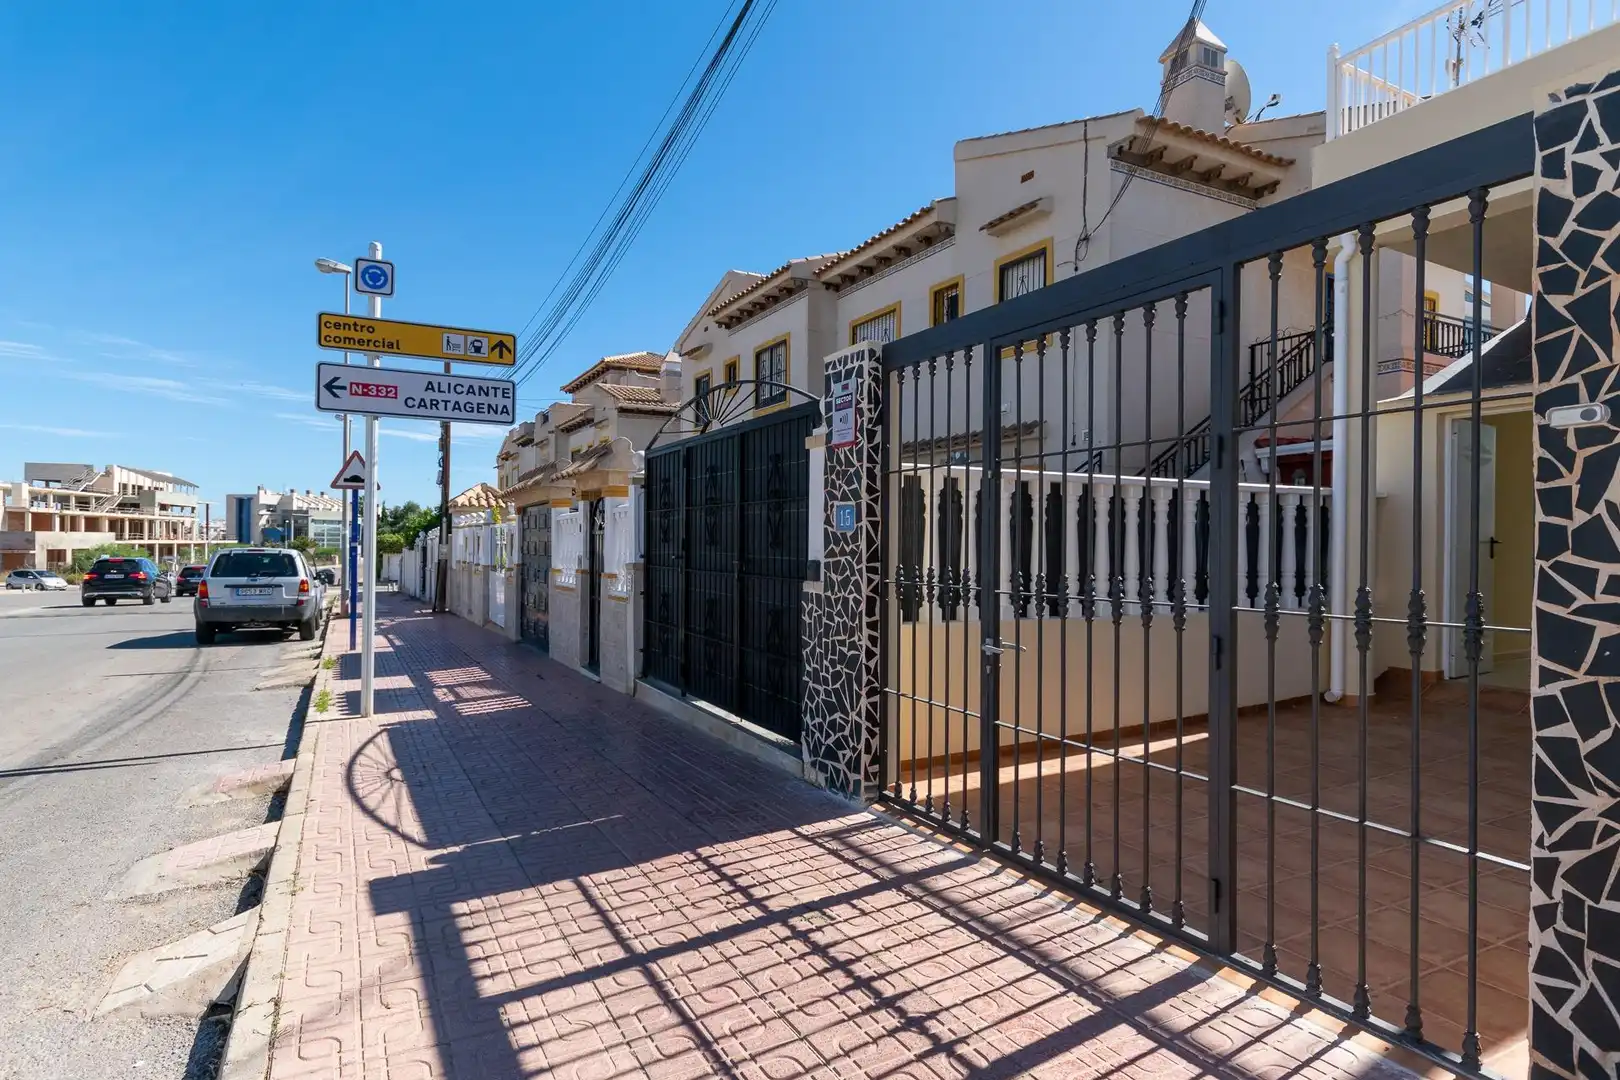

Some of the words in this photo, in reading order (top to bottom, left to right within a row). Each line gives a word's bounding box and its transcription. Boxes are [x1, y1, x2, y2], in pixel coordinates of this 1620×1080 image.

[324, 320, 375, 334] centro
[324, 335, 400, 350] comercial
[351, 383, 396, 398] N-332
[424, 381, 511, 399] ALICANTE
[404, 397, 510, 416] CARTAGENA
[840, 509, 851, 526] 15
